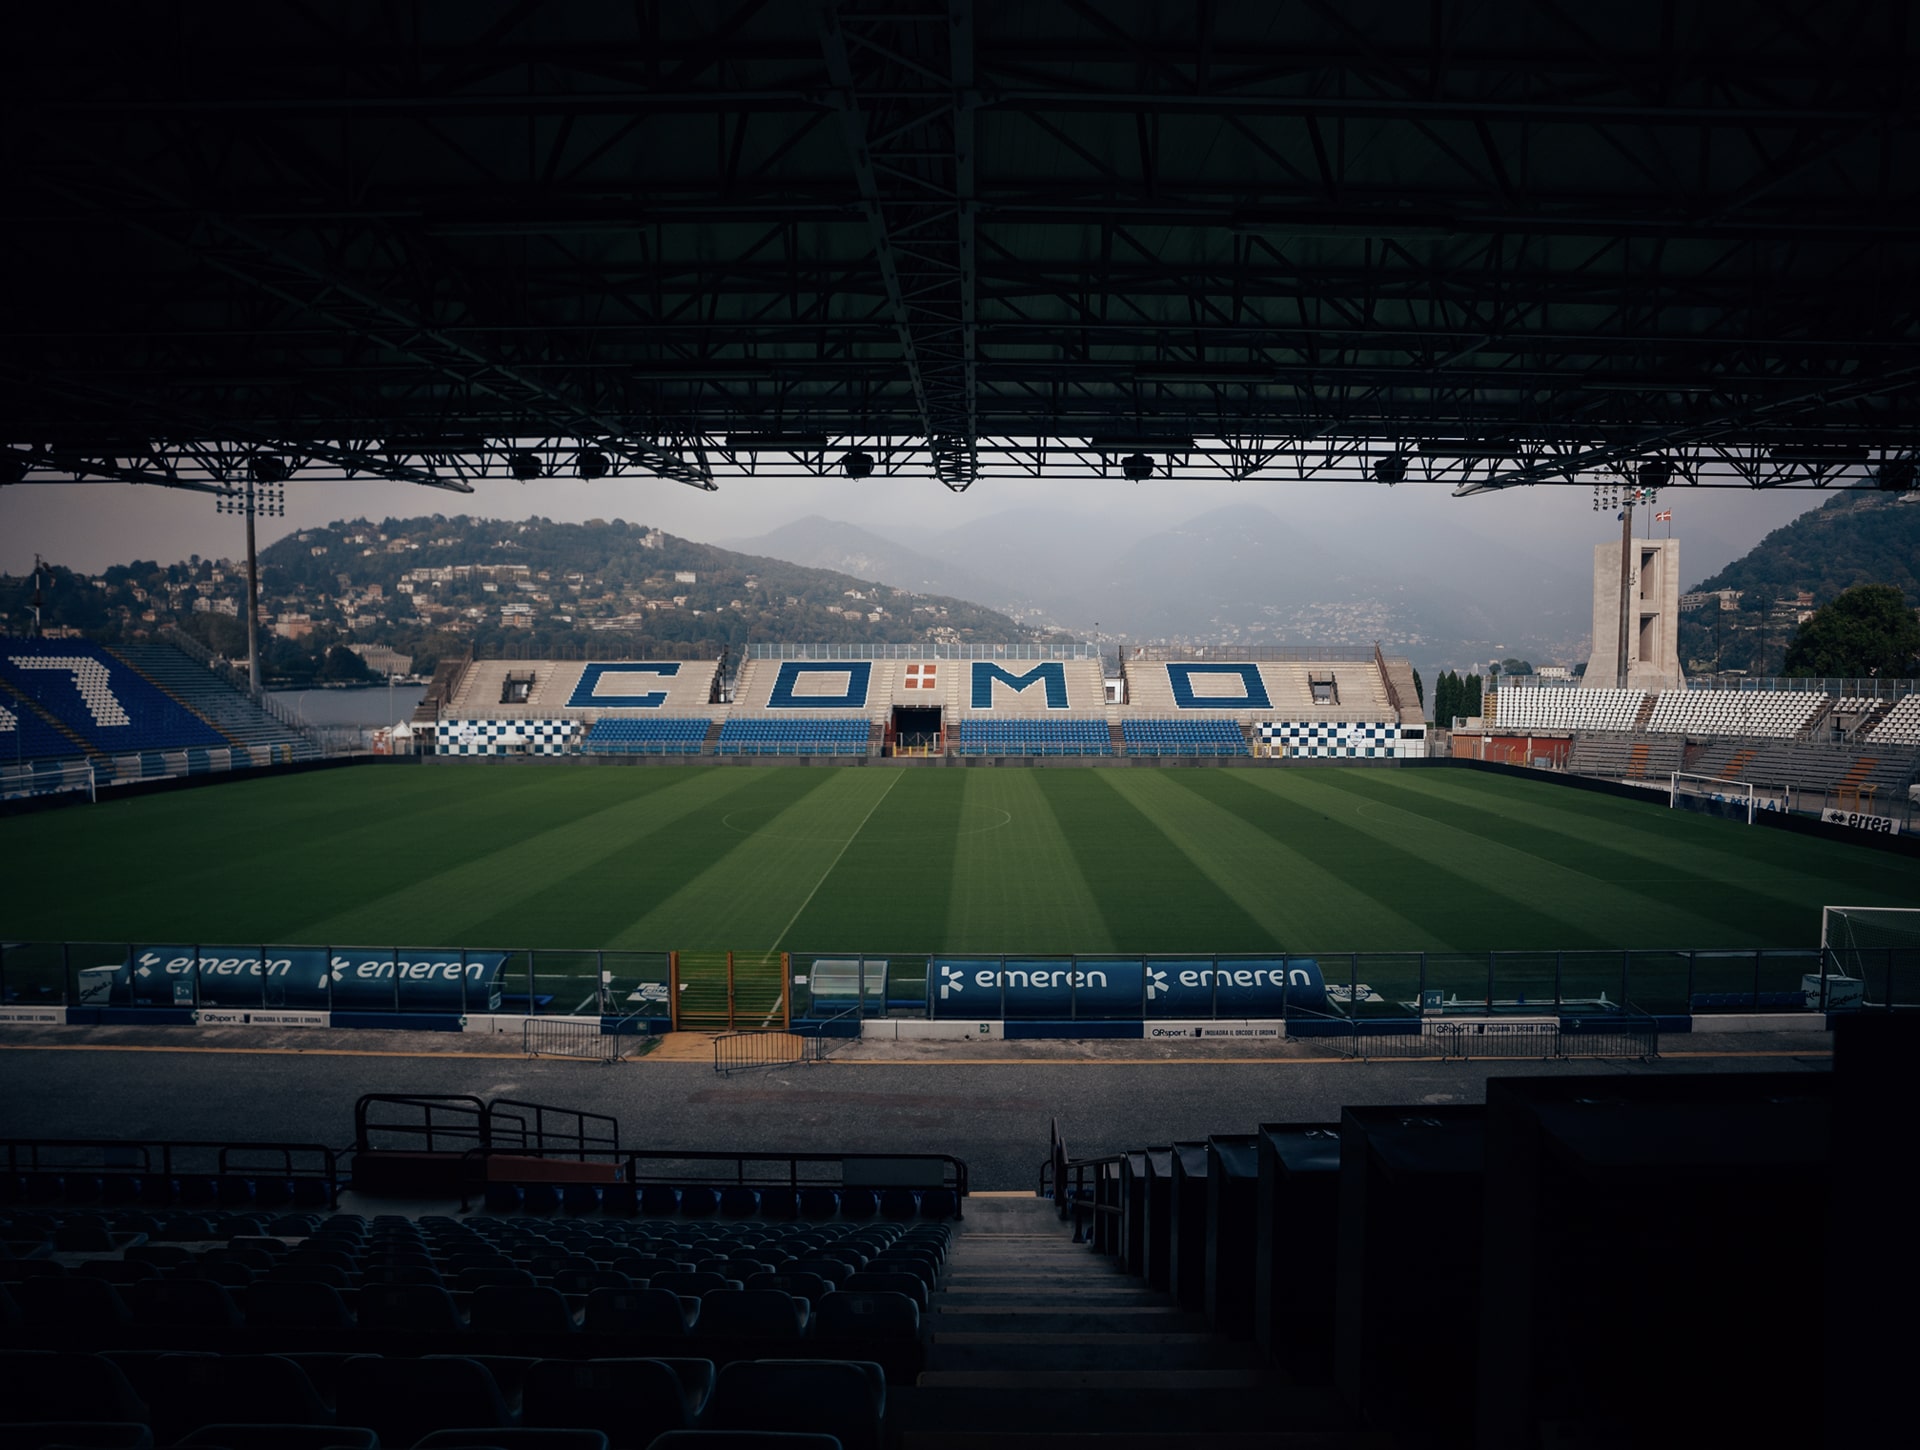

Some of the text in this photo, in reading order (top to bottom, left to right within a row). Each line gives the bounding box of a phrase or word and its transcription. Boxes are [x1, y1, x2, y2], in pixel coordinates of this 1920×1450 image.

[564, 661, 1275, 709] COMO
[165, 956, 292, 976] emeren
[356, 961, 485, 980] emeren
[974, 970, 1108, 988] emeren
[1179, 968, 1311, 987] emeren
[1152, 1028, 1186, 1038] QRsport
